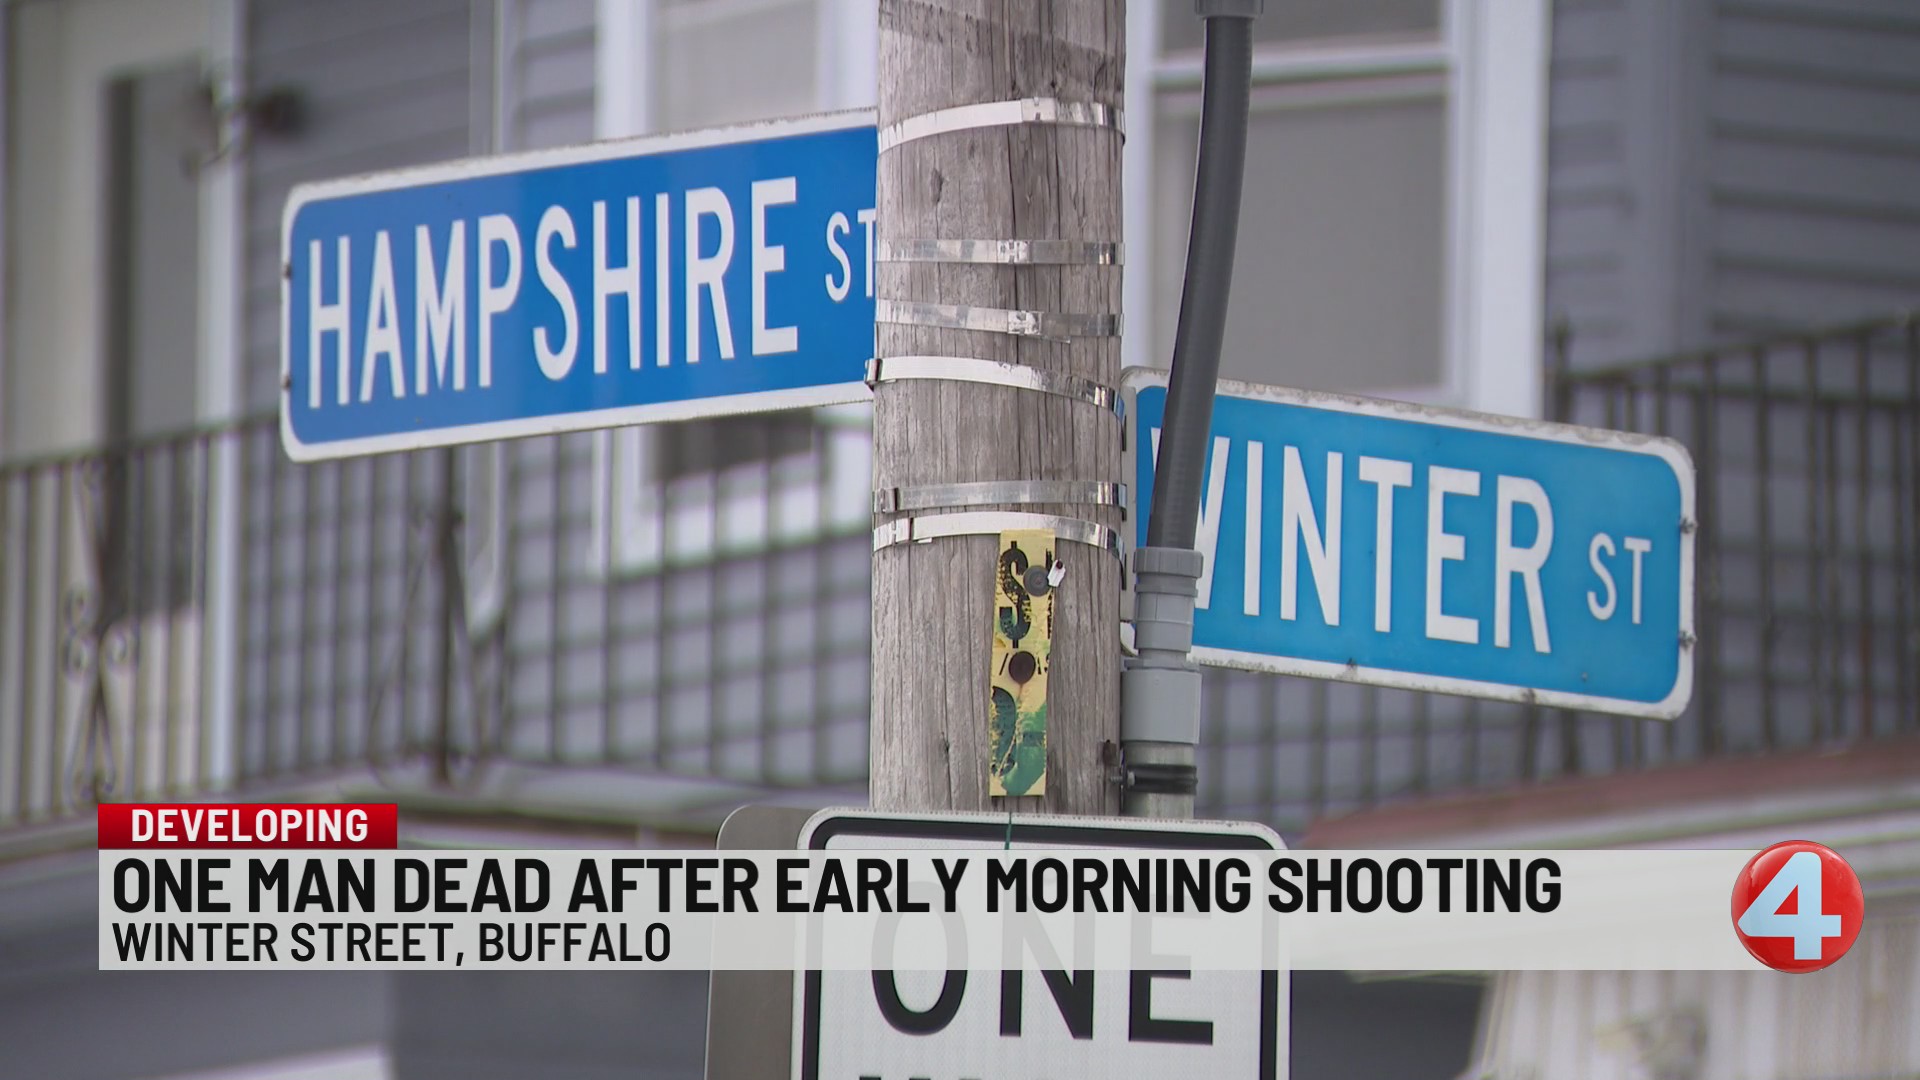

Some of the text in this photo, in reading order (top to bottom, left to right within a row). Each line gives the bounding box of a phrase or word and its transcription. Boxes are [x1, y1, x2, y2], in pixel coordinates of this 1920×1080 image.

[308, 176, 876, 408] HAMPSHIRE ST
[1587, 532, 1652, 624] ST
[871, 882, 1213, 1046] ONE
